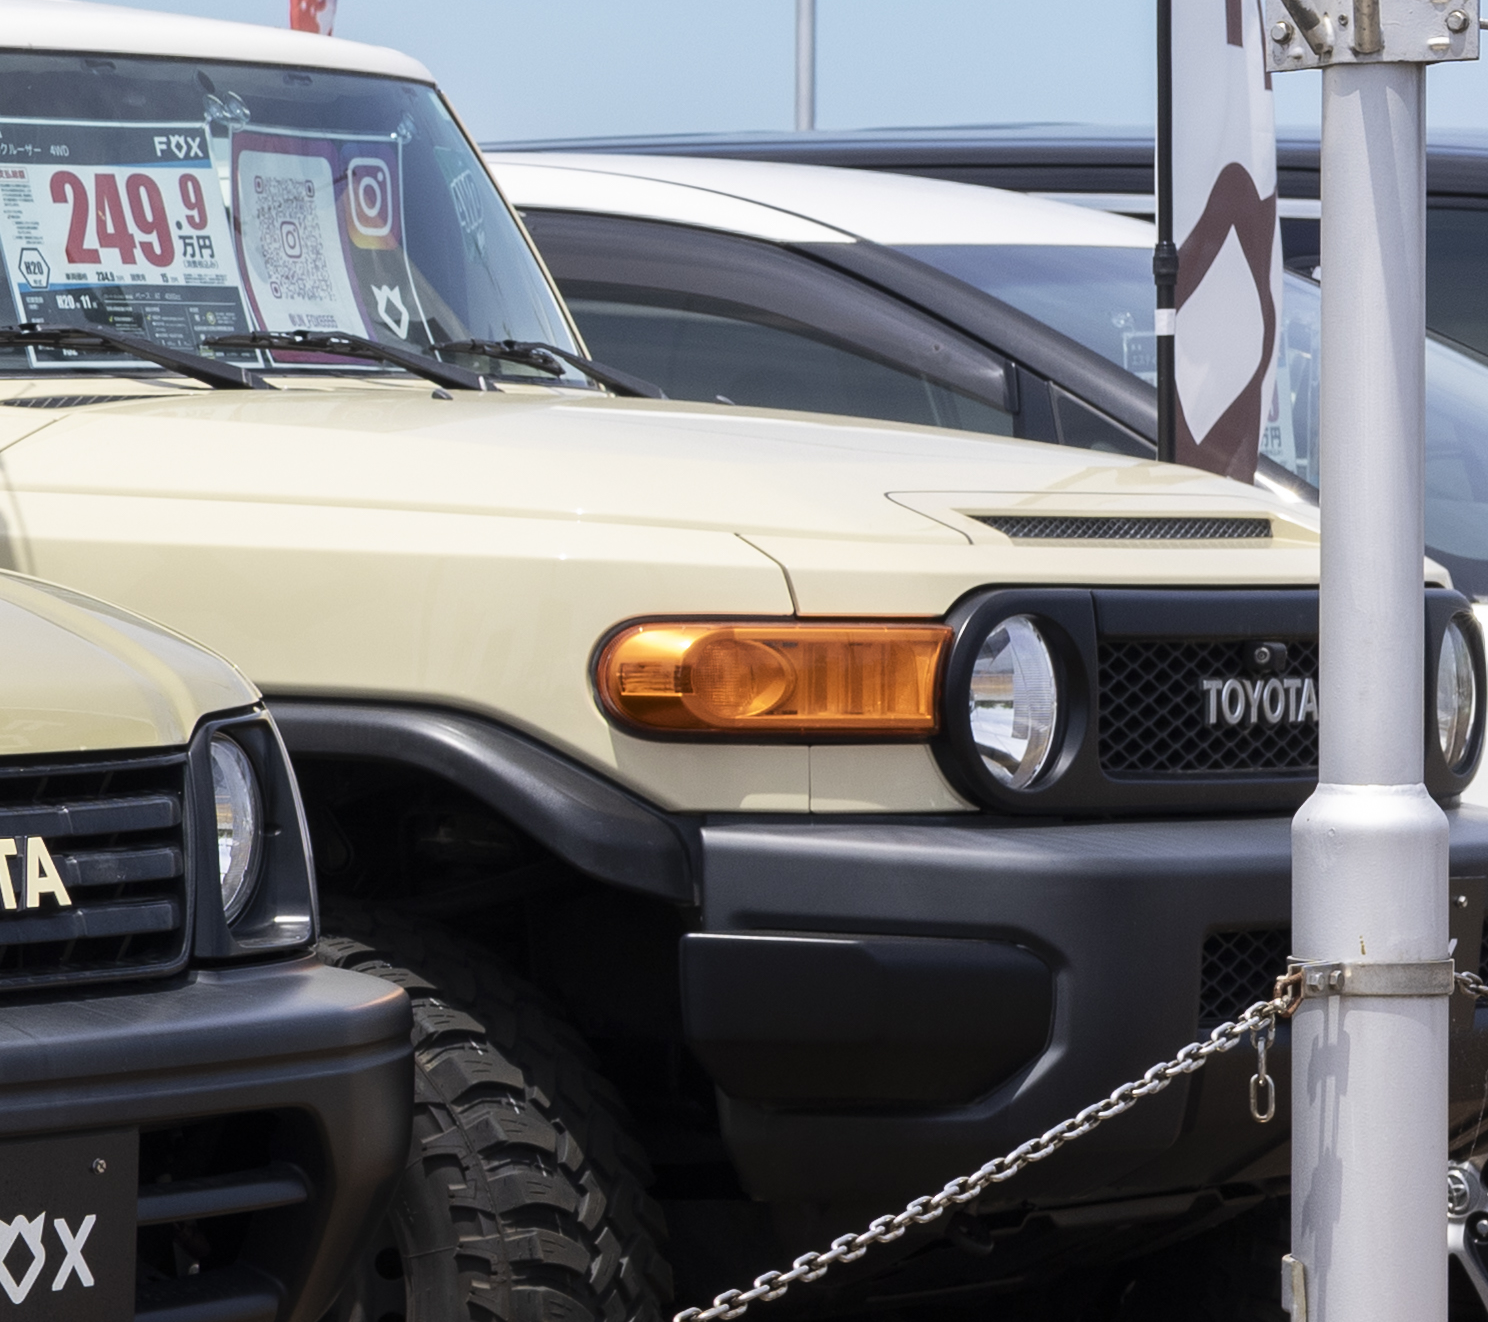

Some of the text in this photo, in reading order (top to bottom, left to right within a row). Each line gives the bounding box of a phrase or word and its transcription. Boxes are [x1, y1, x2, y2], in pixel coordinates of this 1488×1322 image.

[50, 145, 70, 157] 4WD
[153, 134, 204, 159] FOX
[49, 170, 208, 267] 249.9
[178, 235, 216, 259] 万円
[23, 258, 44, 276] H20
[1202, 677, 1319, 726] TOYOTA
